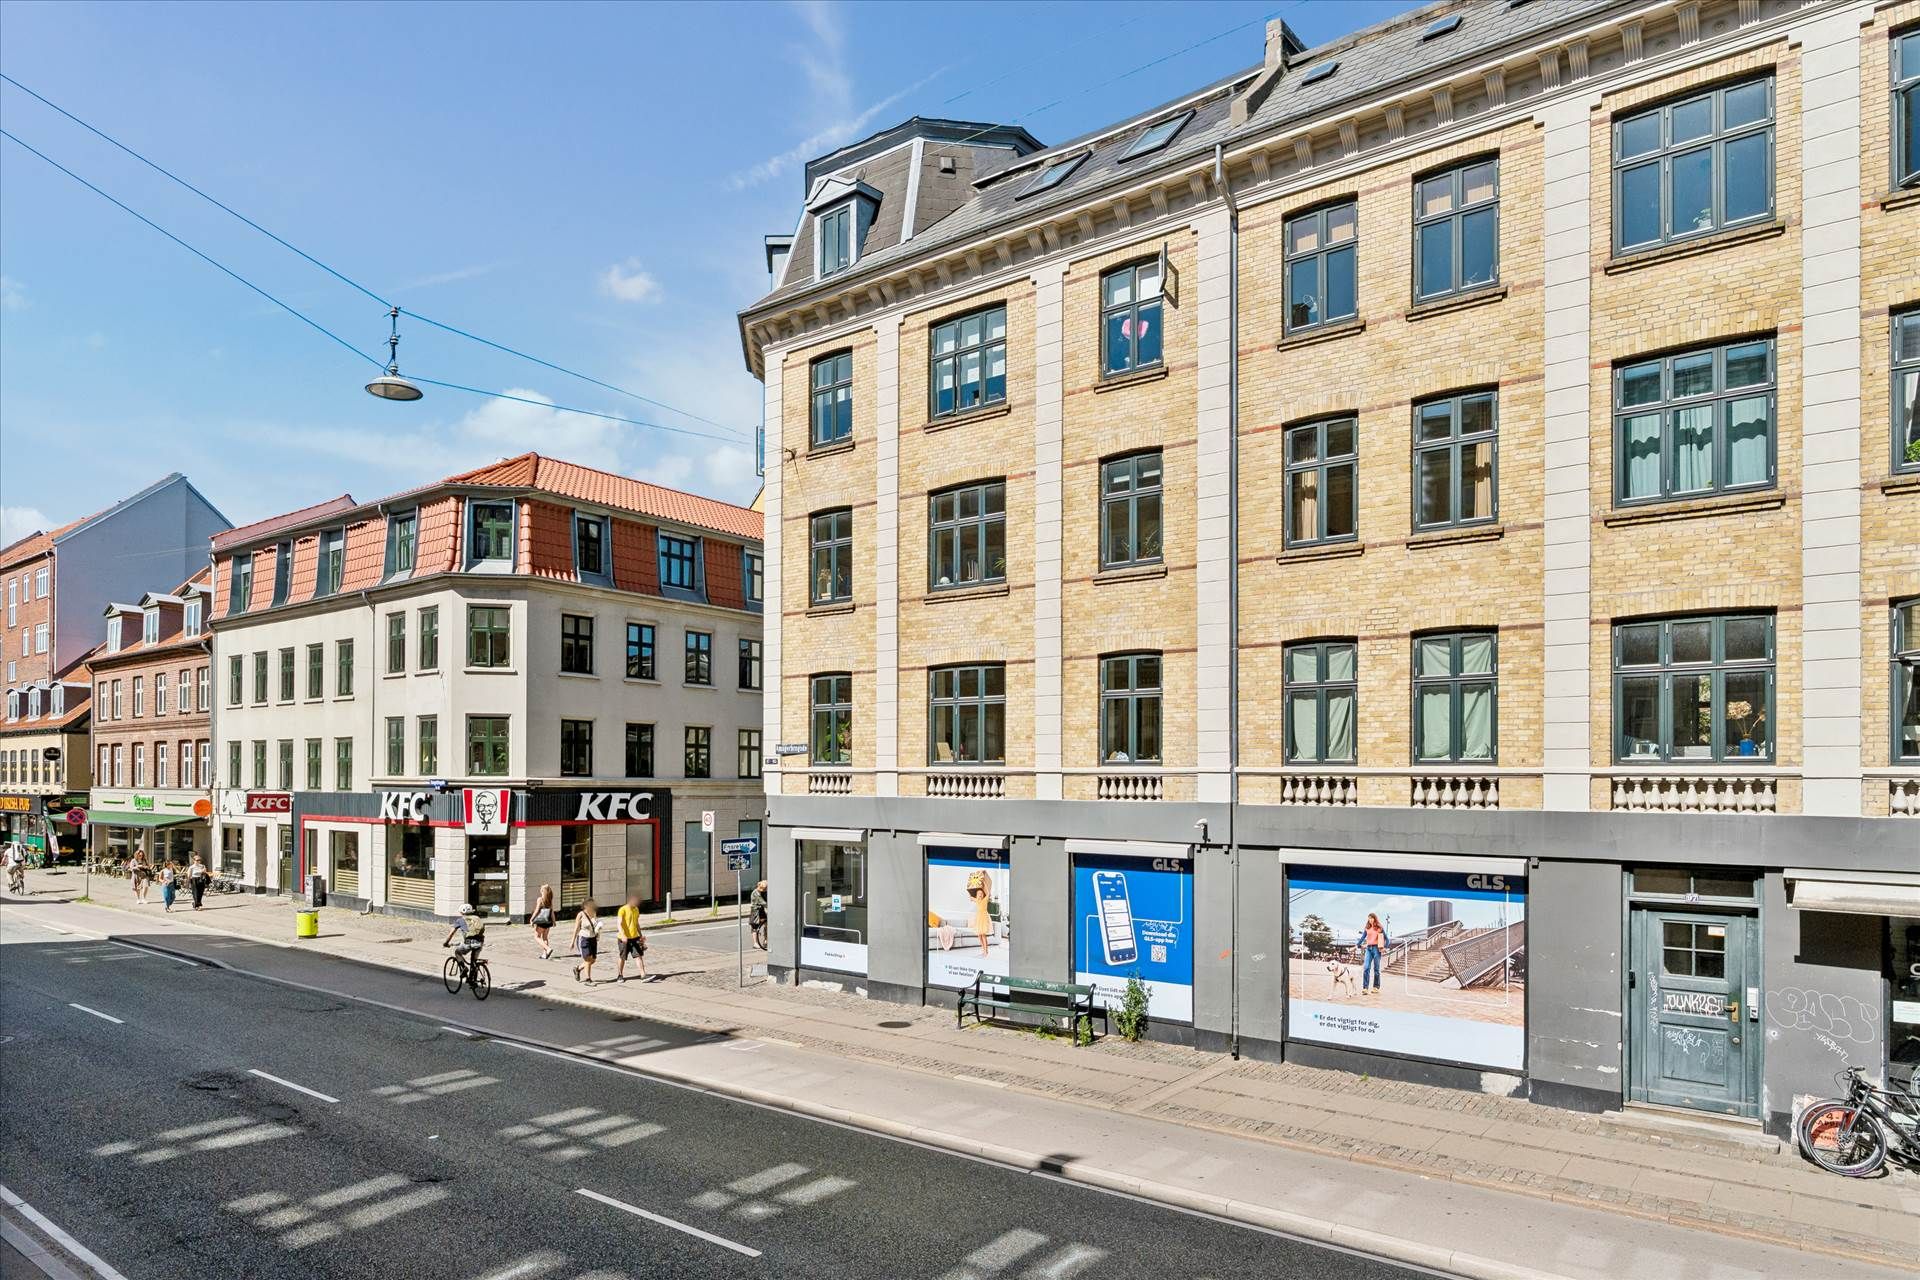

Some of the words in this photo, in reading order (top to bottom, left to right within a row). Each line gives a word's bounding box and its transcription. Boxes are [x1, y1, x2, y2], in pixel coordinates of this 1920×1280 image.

[251, 797, 288, 810] KFC
[379, 791, 425, 821] KFC
[574, 791, 654, 821] KFC
[1337, 1017, 1357, 1025] vigtigt
[1337, 1024, 1357, 1032] vigtigt
